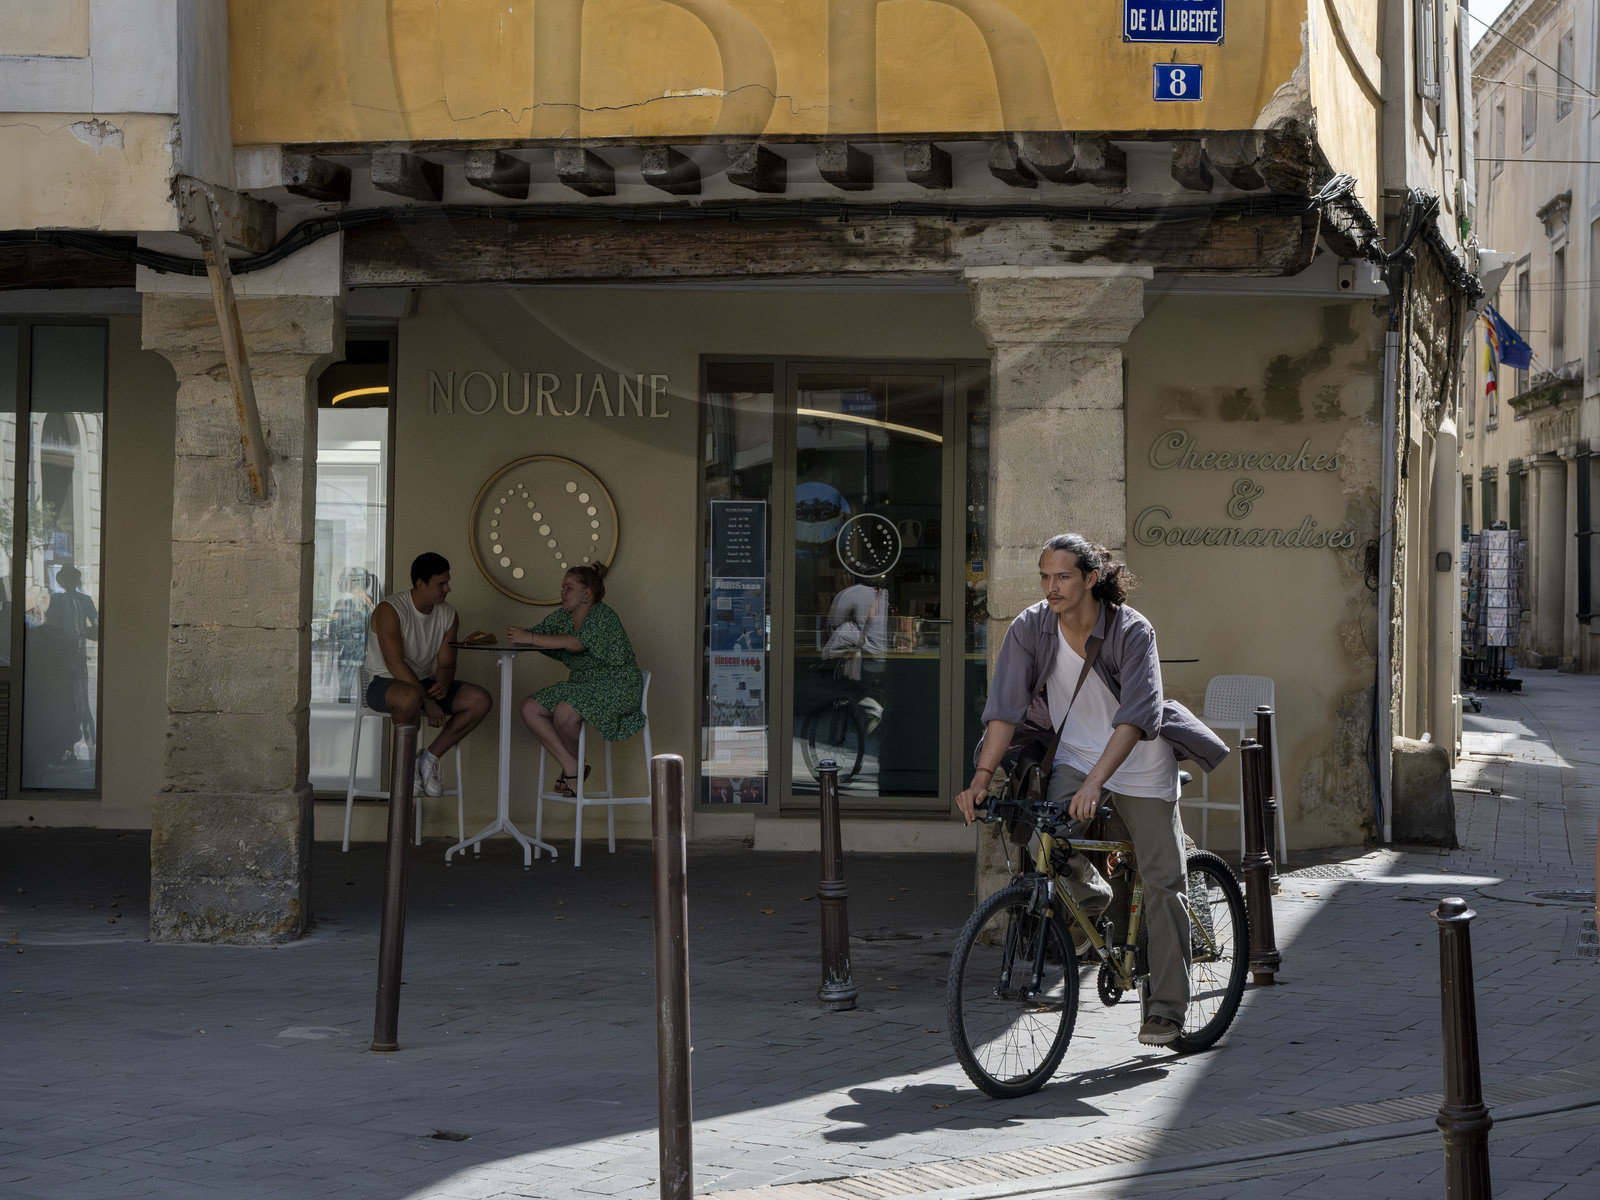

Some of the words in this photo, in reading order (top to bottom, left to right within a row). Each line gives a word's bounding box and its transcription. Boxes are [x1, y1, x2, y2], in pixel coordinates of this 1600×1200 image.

[1130, 8, 1147, 31] DE
[1151, 9, 1165, 31] LA
[1170, 7, 1218, 32] LIBERTÉ
[1169, 68, 1187, 96] 8
[428, 370, 670, 418] NOURJANE
[1149, 429, 1343, 472] Cheesecakes
[1226, 478, 1264, 520] &
[1133, 505, 1358, 548] Gourmandises
